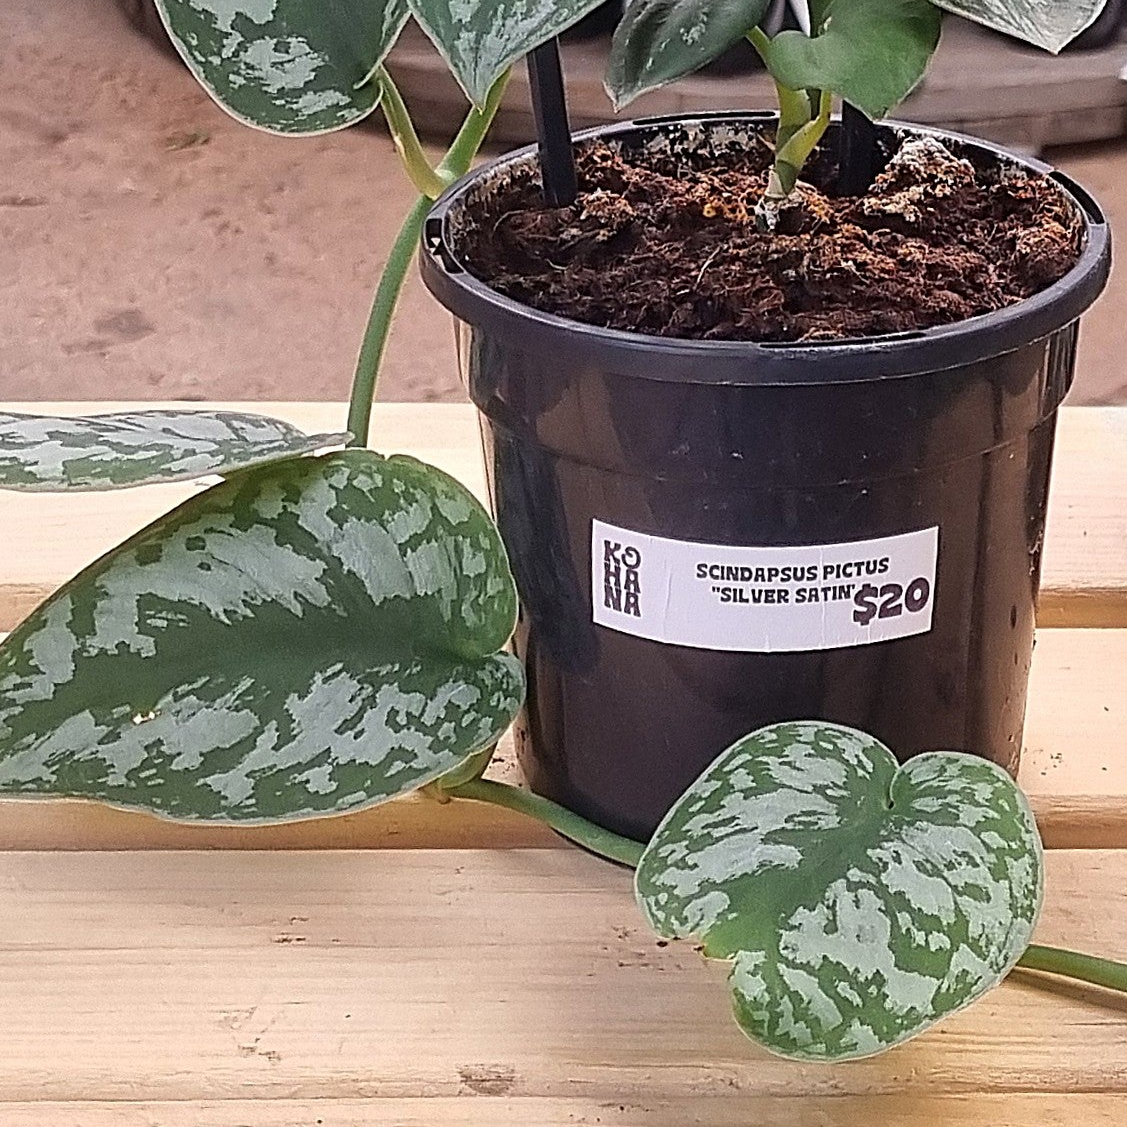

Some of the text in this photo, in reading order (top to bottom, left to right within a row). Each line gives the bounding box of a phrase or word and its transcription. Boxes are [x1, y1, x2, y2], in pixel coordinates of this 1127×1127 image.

[697, 557, 889, 582] SCINDAPSUS PICTUS
[712, 587, 789, 604] "SILVER
[853, 577, 930, 625] $20
